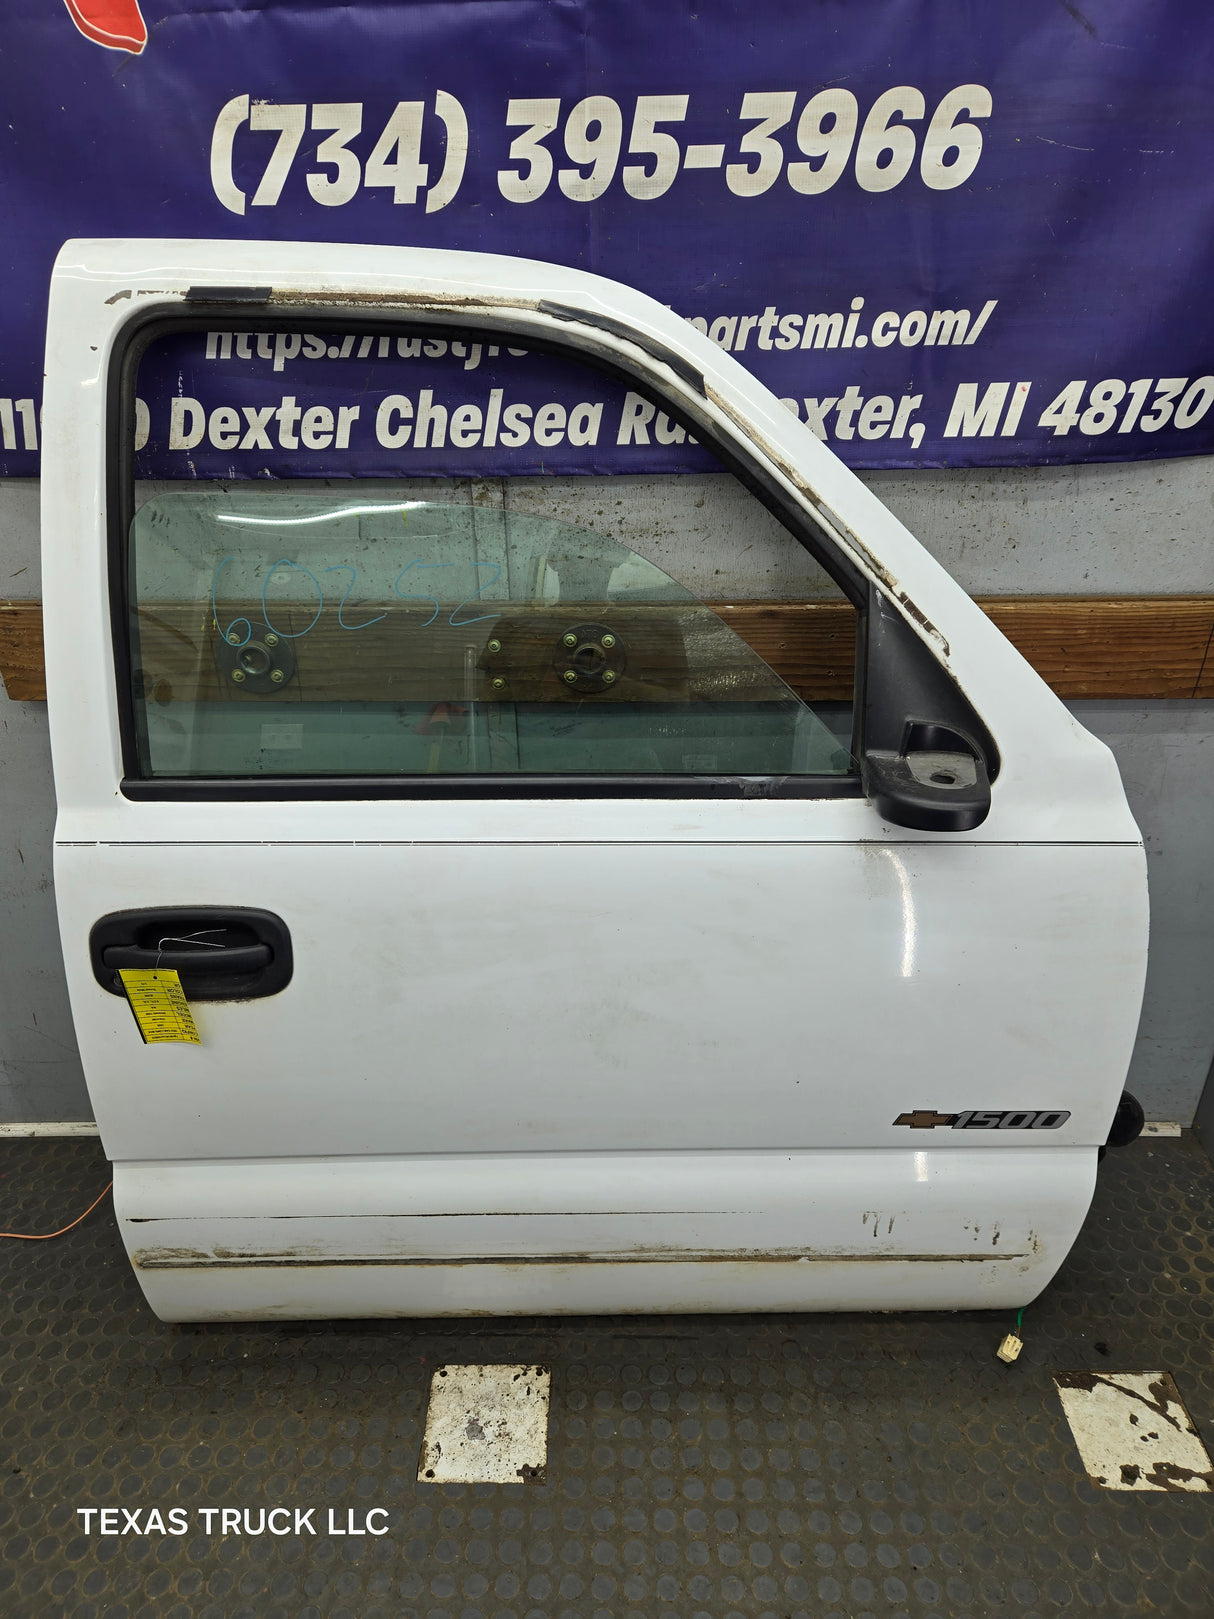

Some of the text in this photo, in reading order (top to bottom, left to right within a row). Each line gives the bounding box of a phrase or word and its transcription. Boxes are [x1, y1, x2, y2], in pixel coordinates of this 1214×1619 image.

[210, 83, 993, 215] (734) 395-3966
[168, 396, 360, 450] Dexter
[375, 388, 604, 449] Chelsea
[943, 381, 1032, 438] MI
[1037, 375, 1214, 436] 48130
[951, 1110, 1072, 1130] 1500
